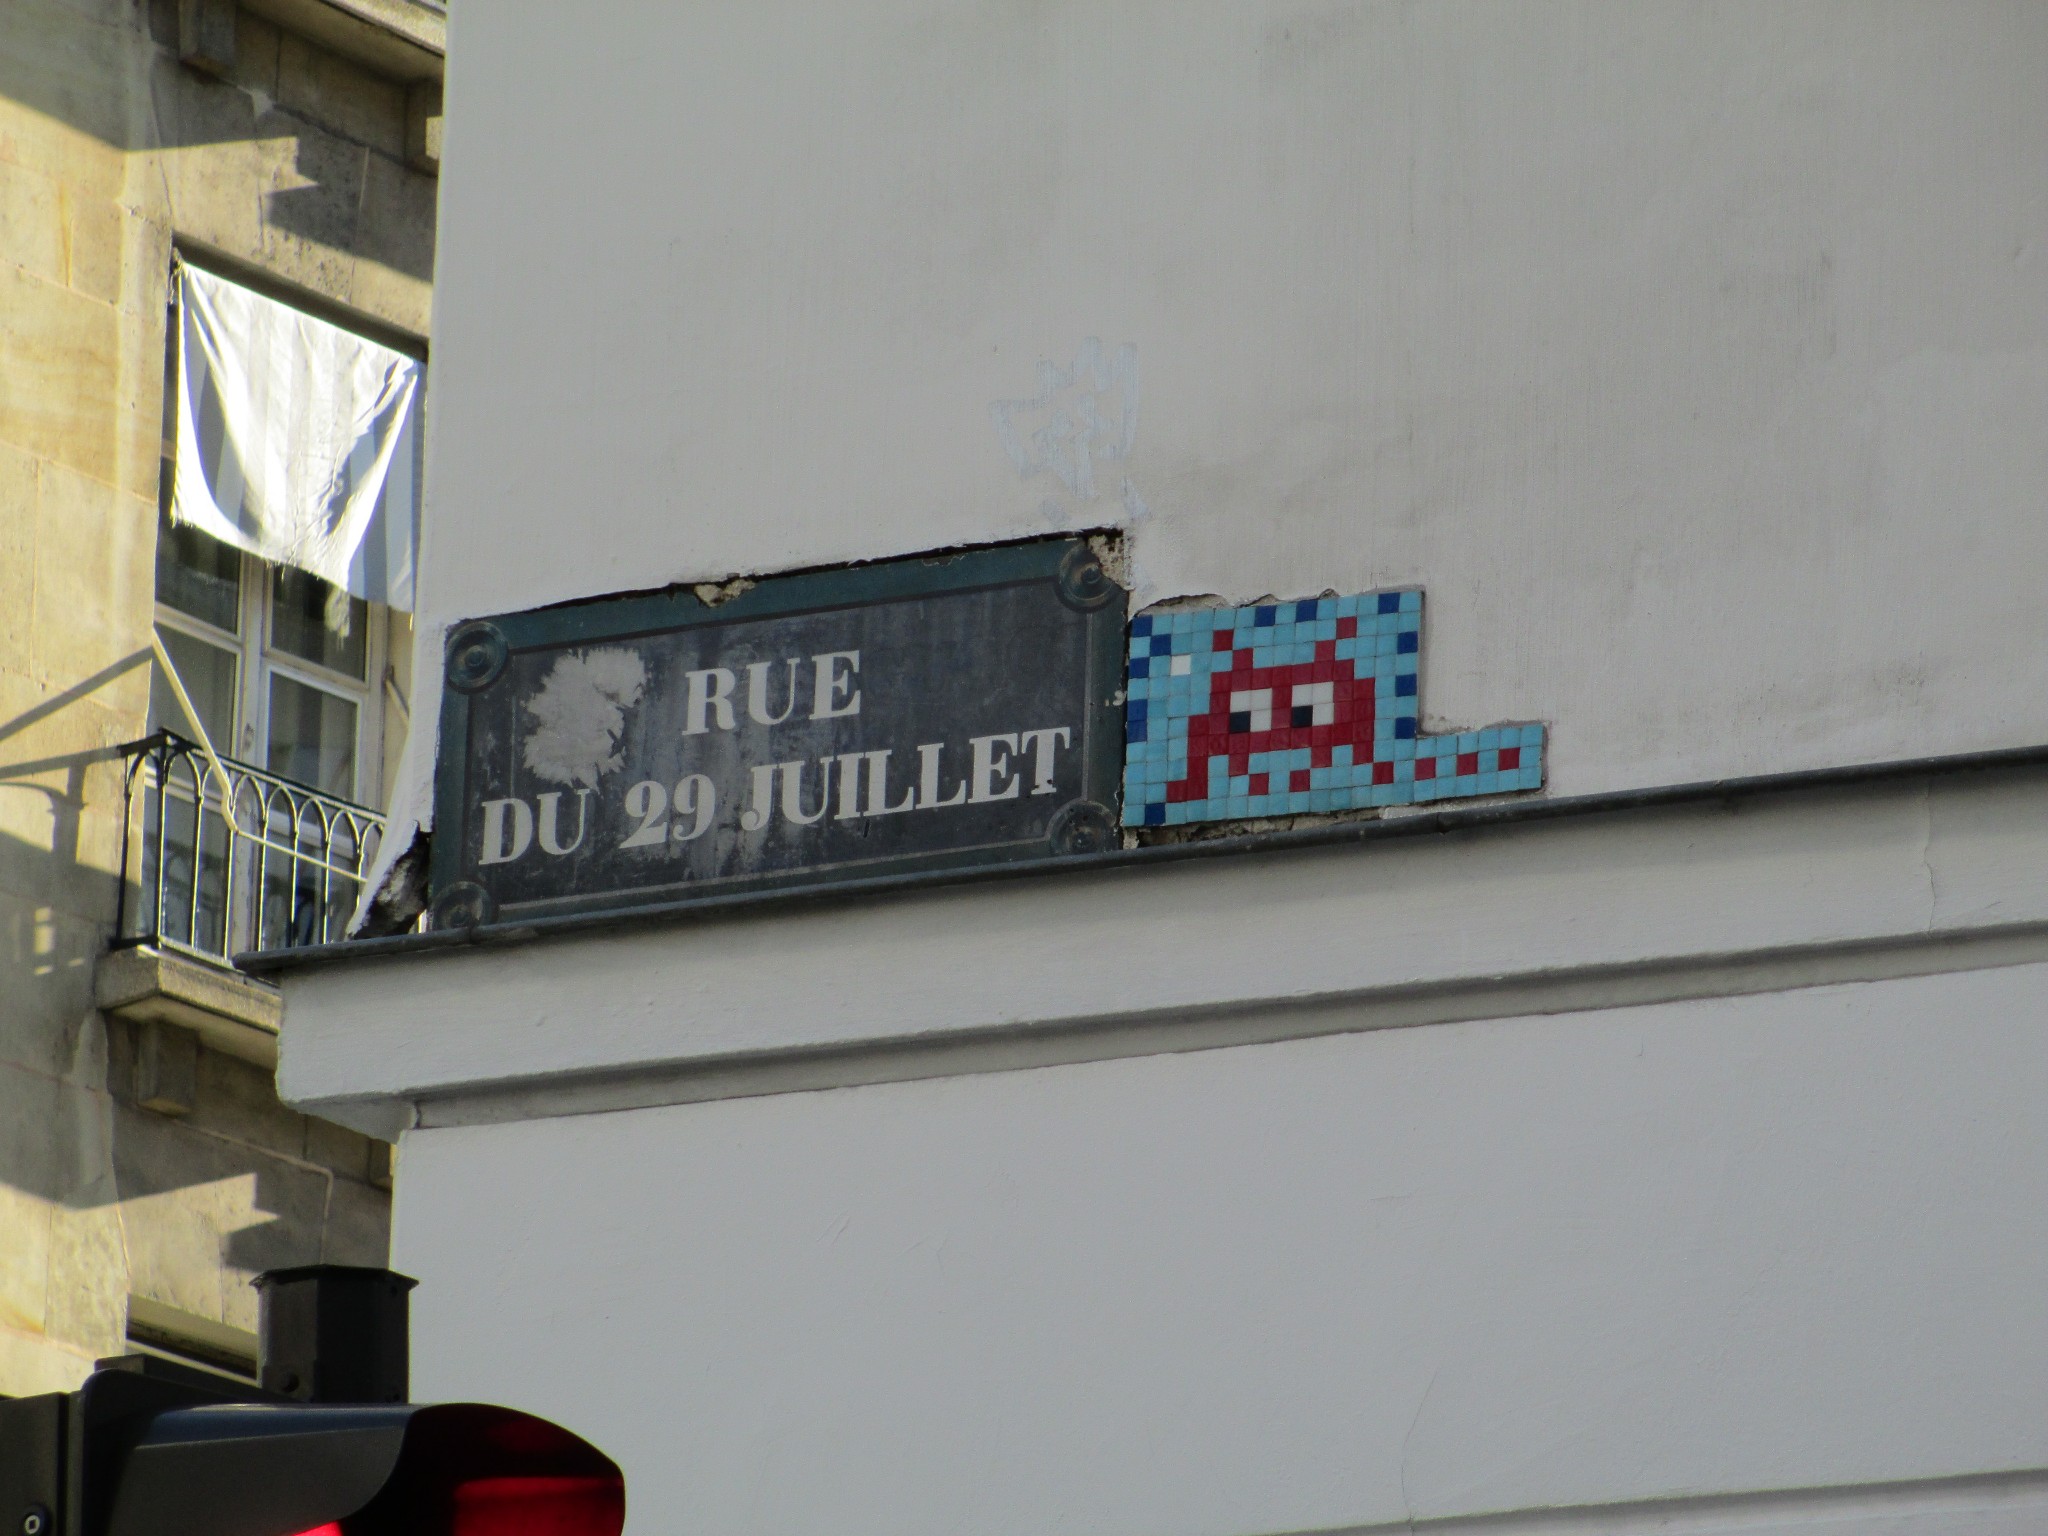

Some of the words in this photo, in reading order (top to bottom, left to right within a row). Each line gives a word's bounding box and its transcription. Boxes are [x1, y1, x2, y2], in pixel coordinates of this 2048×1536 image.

[682, 650, 861, 736] RUE
[478, 788, 593, 866] DU
[618, 773, 716, 849] 29
[741, 727, 1071, 833] JUILLET
